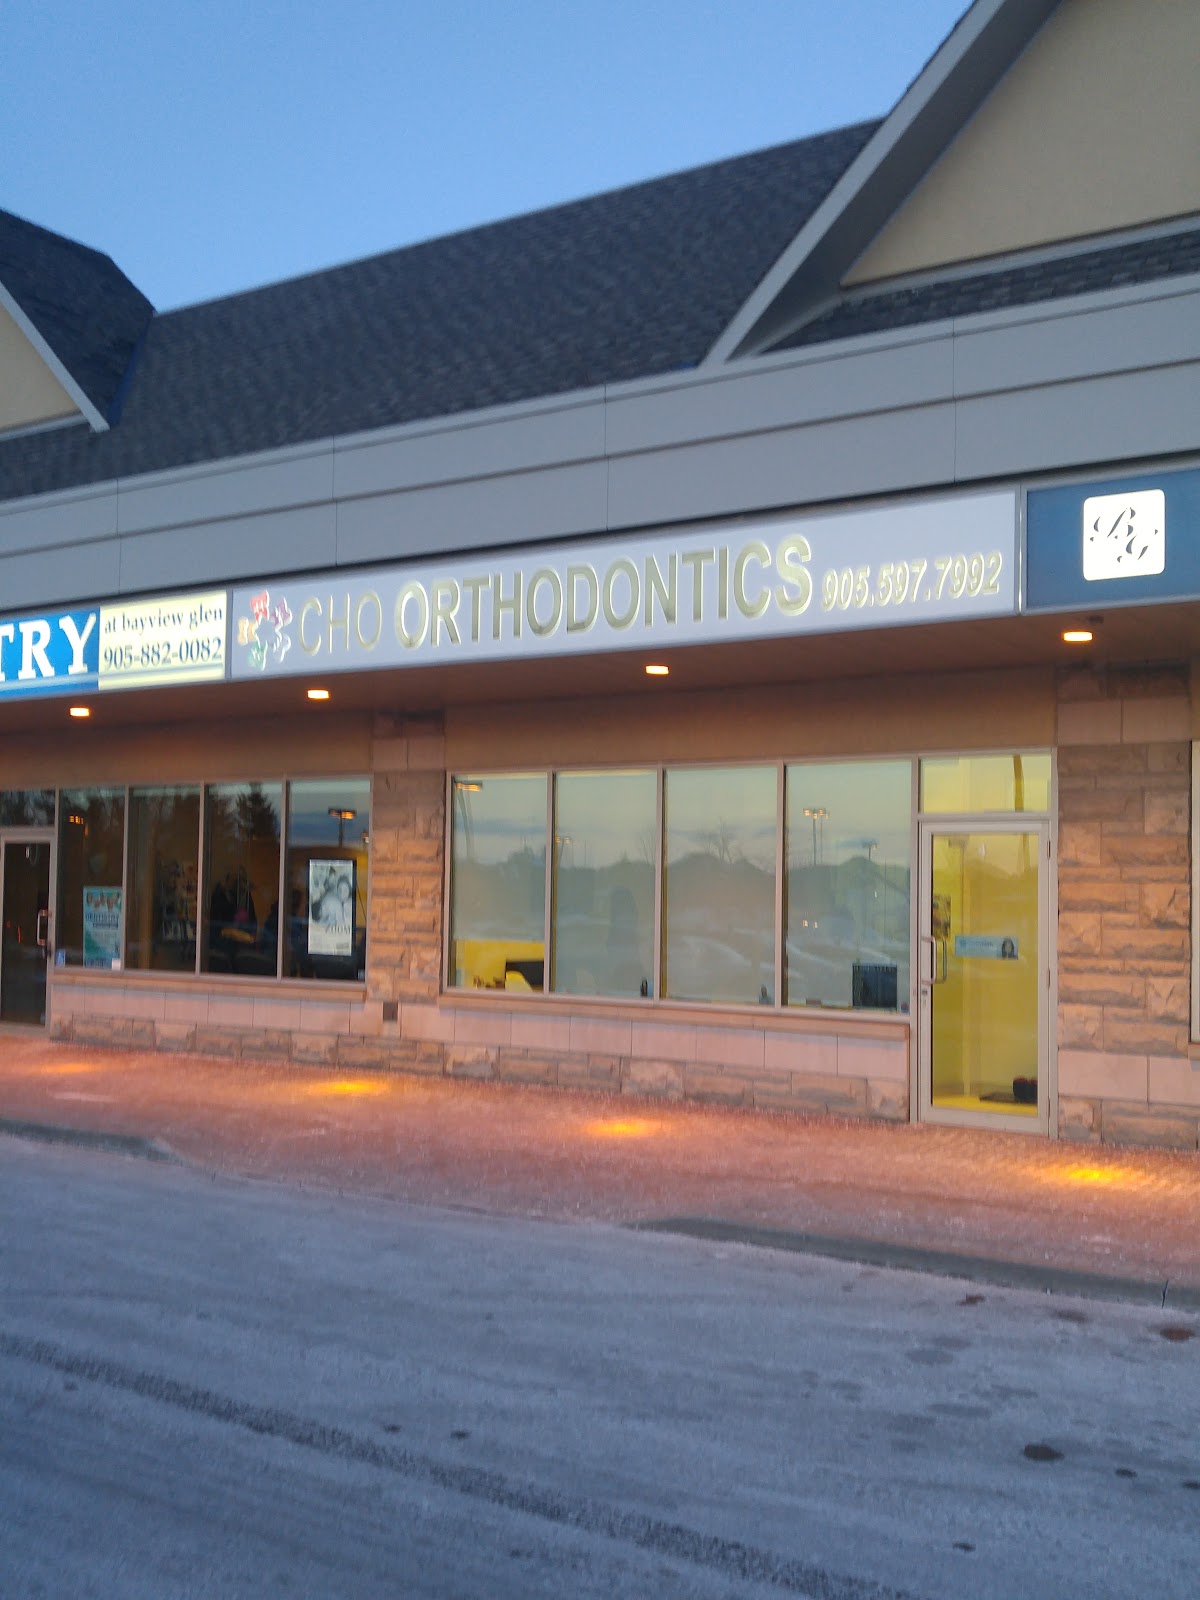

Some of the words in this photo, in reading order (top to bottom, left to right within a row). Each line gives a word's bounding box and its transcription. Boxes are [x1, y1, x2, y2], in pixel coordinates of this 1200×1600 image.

[298, 590, 383, 657] CHO
[395, 532, 813, 650] ORTHODONTICS
[821, 550, 1003, 611] 905.597.7992
[104, 614, 117, 633] at
[122, 608, 183, 636] bayview
[188, 602, 223, 629] glen
[103, 637, 223, 670] 905-882-0082
